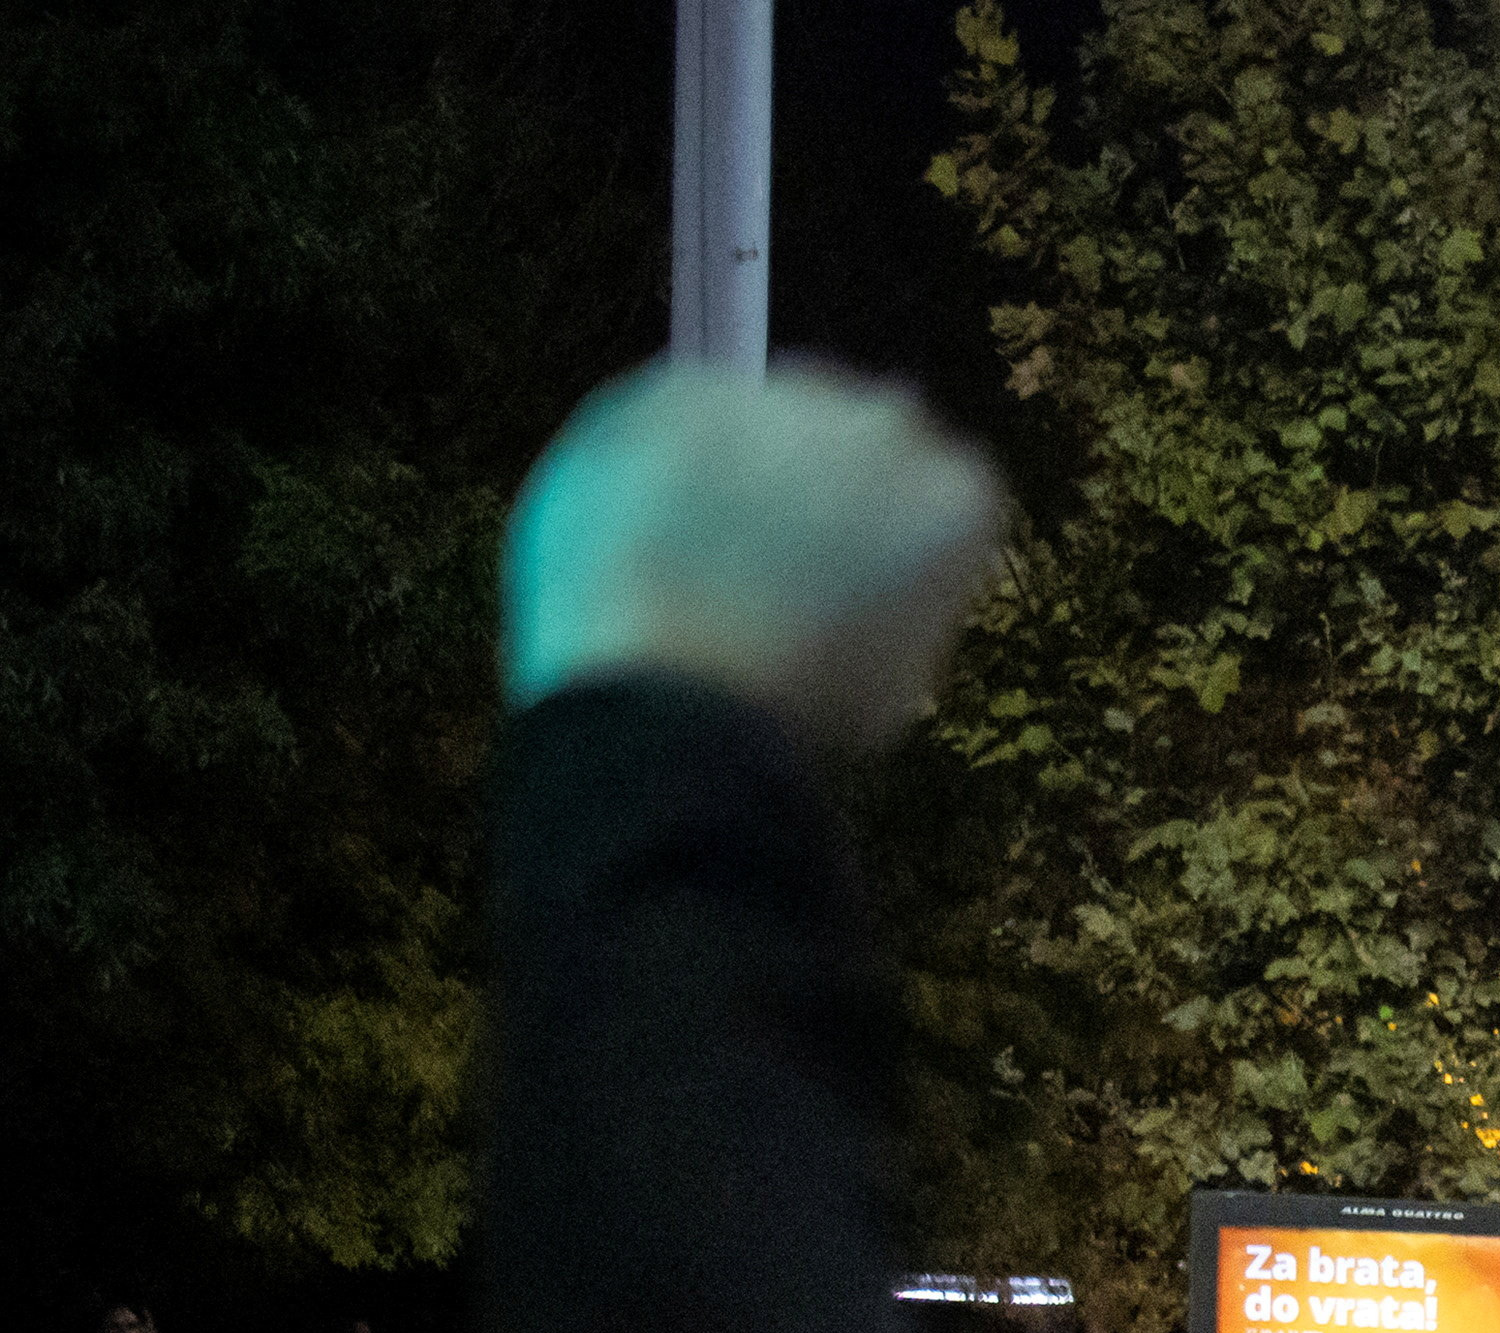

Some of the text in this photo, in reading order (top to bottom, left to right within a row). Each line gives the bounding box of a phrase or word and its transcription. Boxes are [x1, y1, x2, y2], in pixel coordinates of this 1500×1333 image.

[1244, 1244, 1437, 1294] Za brata,
[1244, 1285, 1438, 1331] do vrata!
